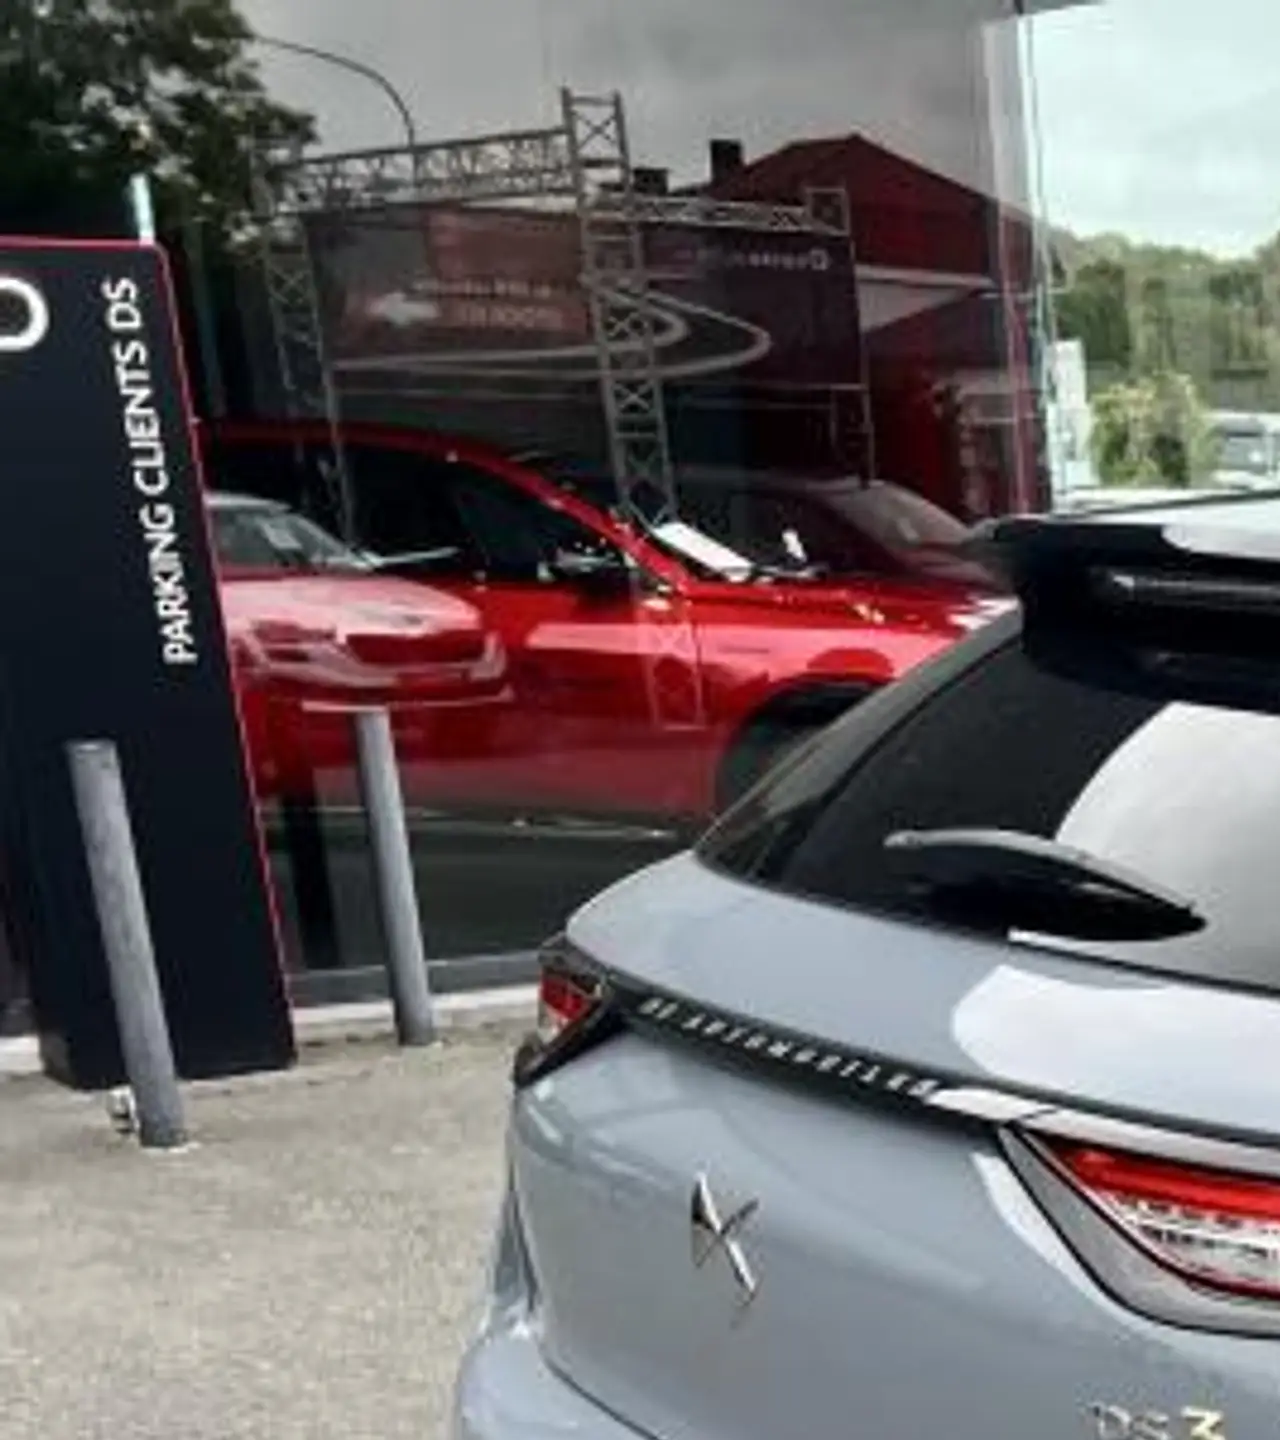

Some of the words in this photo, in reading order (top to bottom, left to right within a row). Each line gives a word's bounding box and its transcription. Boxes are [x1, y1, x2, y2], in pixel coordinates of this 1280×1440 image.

[102, 276, 142, 333] DS
[113, 341, 168, 497] CLIENTS
[139, 501, 198, 666] PARKING
